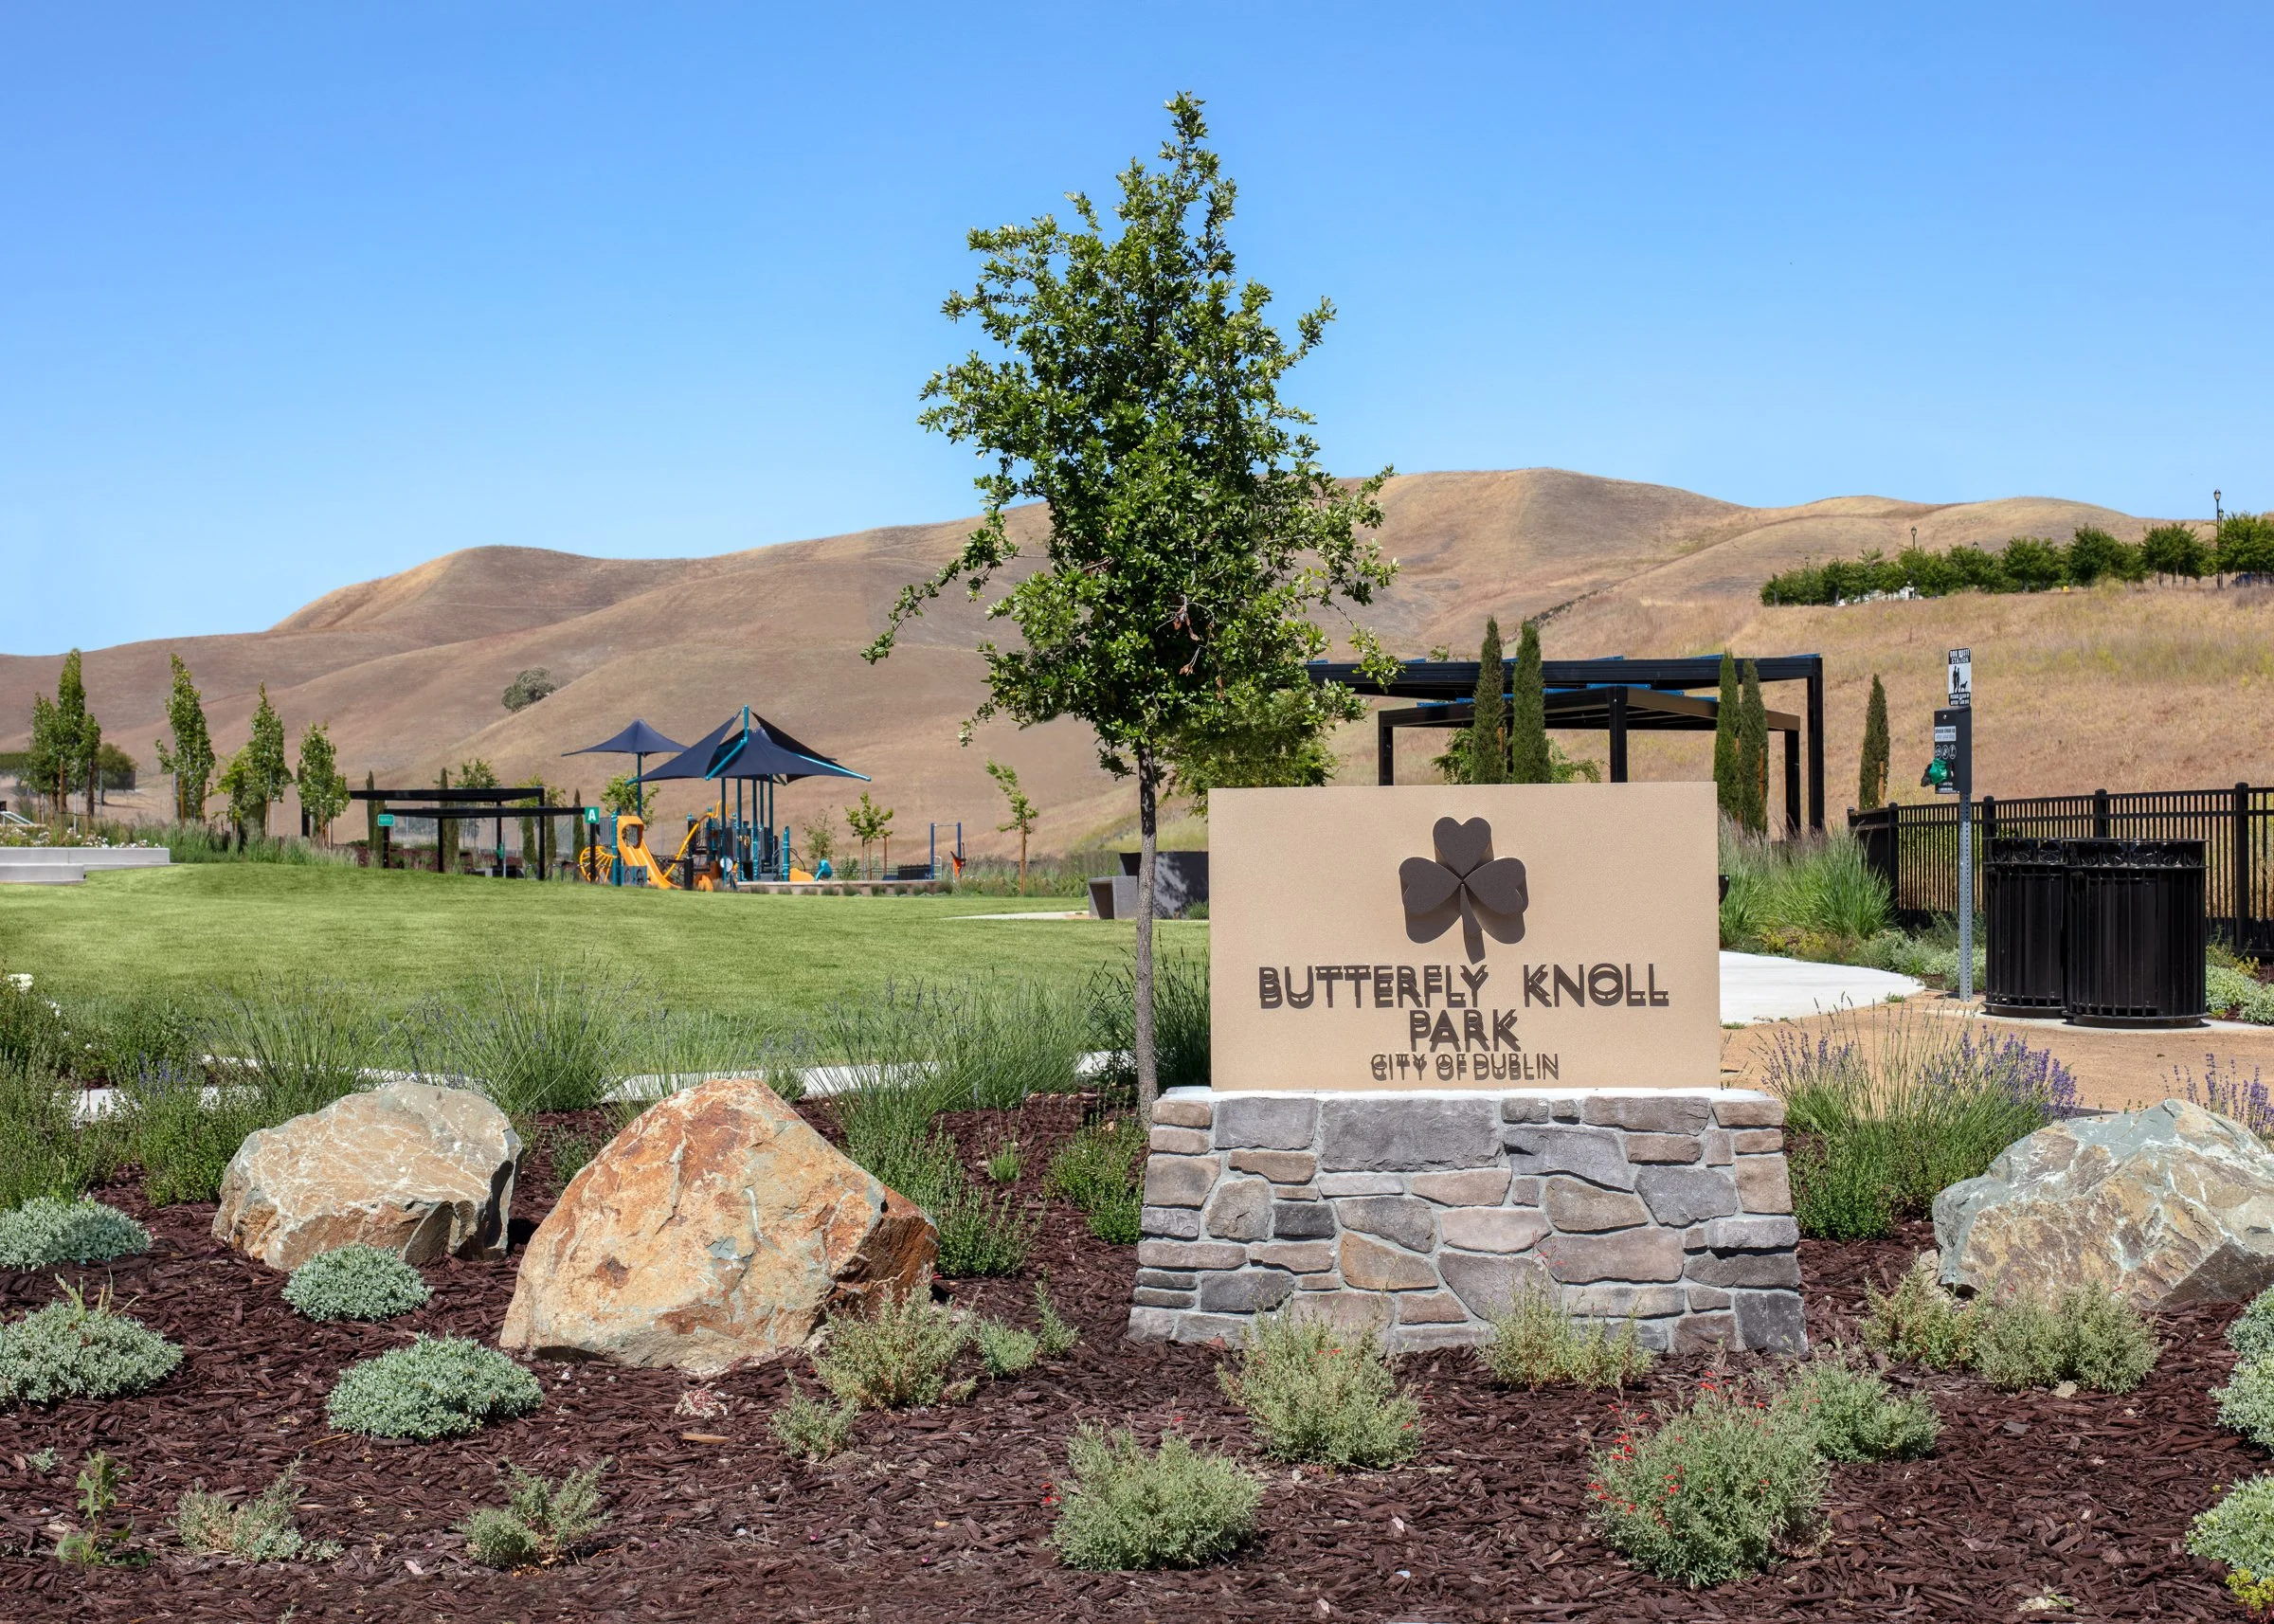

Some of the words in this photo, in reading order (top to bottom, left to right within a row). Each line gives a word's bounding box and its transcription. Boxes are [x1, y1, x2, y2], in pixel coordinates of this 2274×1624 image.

[587, 808, 597, 821] A
[1258, 965, 1489, 1008] BUTTERFLY
[1522, 963, 1669, 1007] KNOLL
[1409, 1009, 1521, 1052] PARK
[1371, 1054, 1428, 1080] CITY
[1435, 1054, 1468, 1080] OF
[1472, 1053, 1560, 1080] DUBLIN
